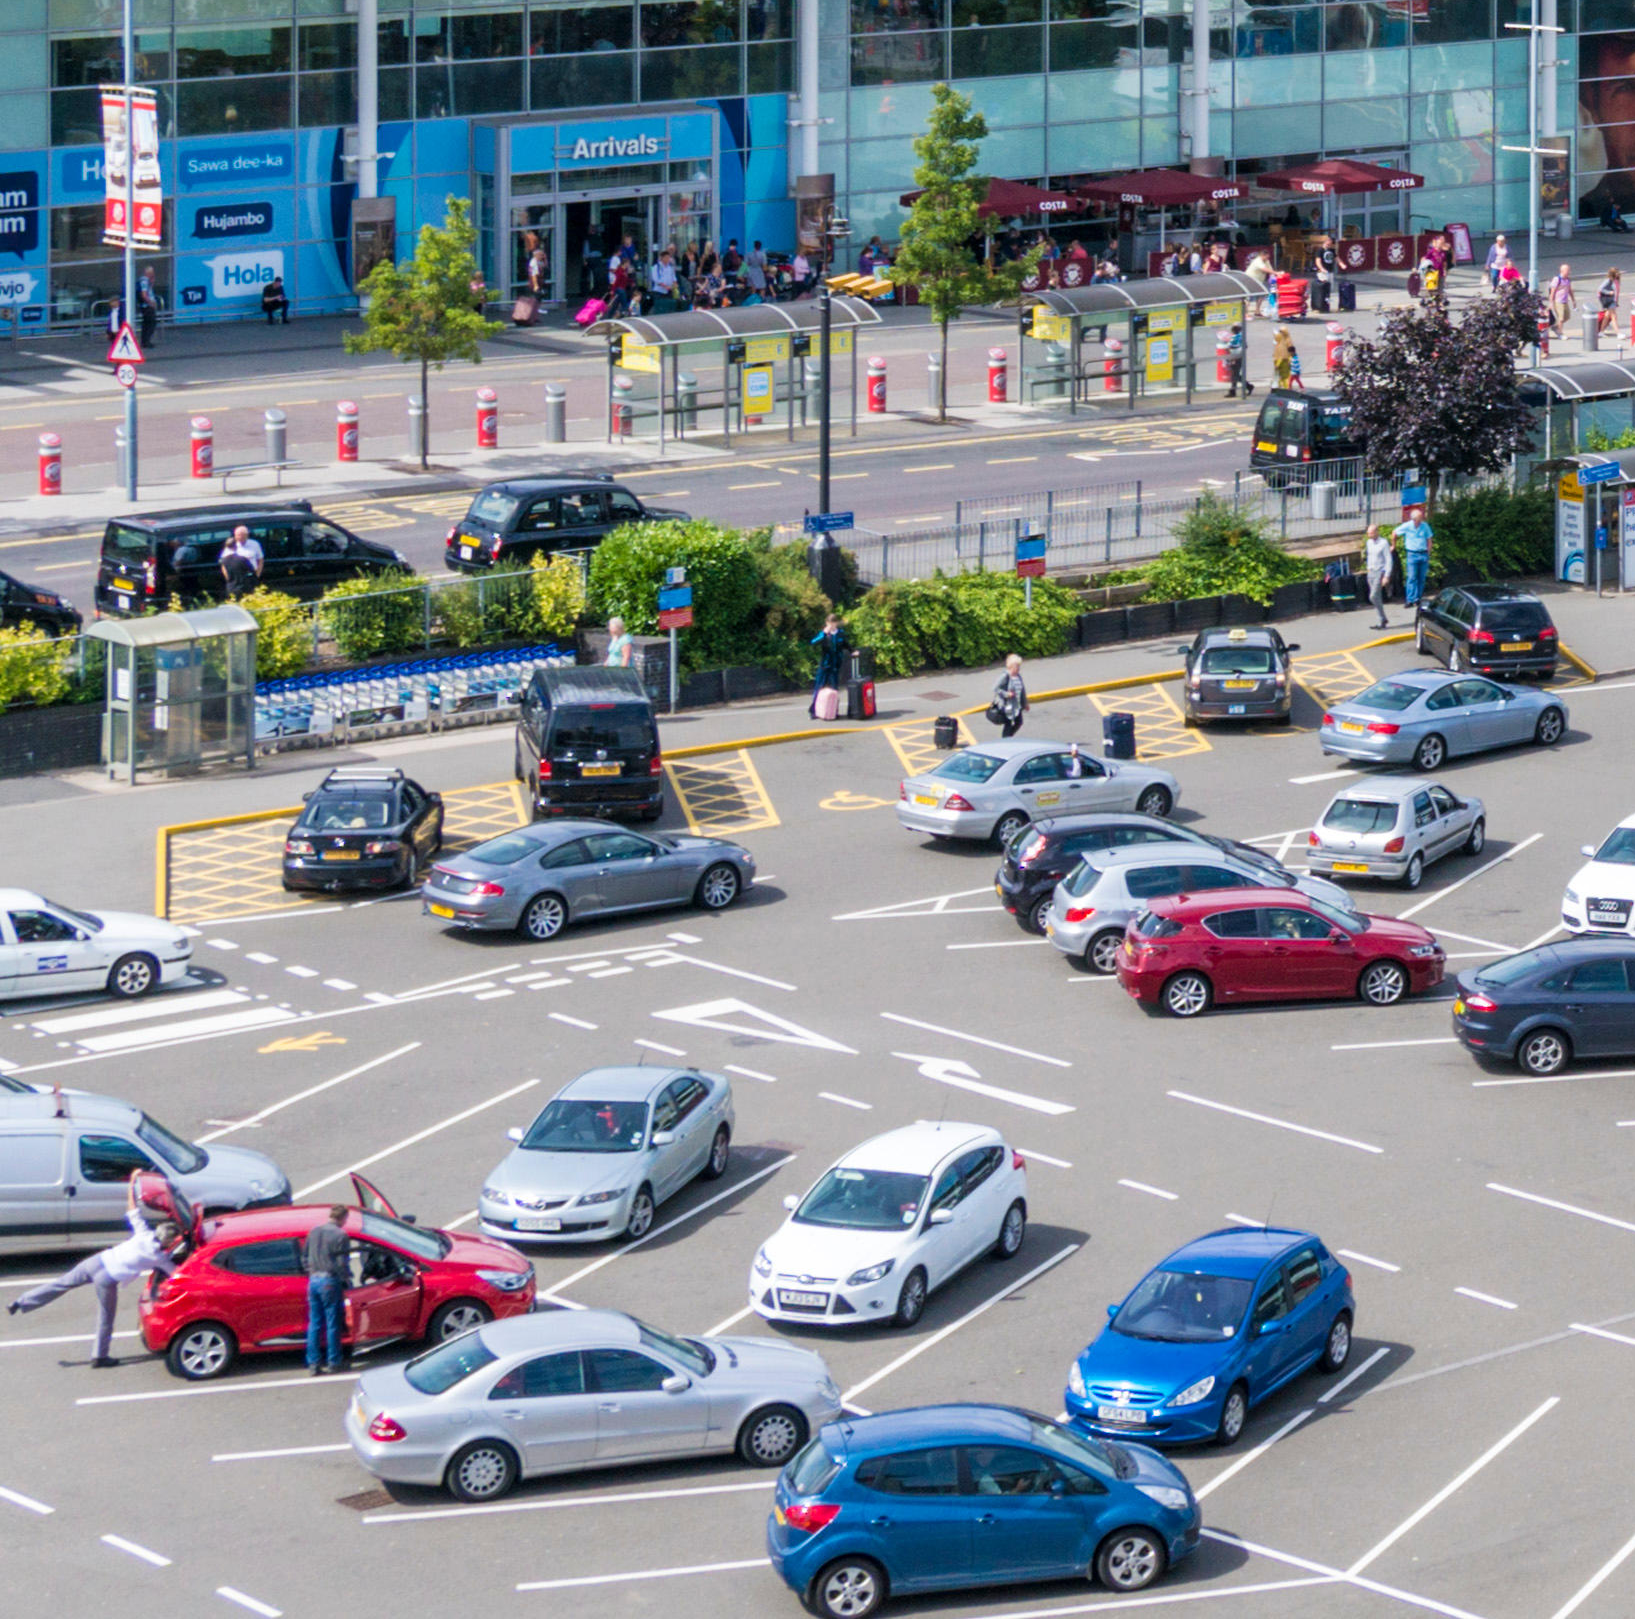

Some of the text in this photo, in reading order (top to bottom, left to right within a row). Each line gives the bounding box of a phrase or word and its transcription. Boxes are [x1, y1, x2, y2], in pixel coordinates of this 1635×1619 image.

[572, 134, 659, 160] Arrivals
[188, 154, 284, 173] Sawa dee-ka
[1302, 181, 1325, 192] COSTA
[1390, 178, 1415, 189] COSTA
[1121, 193, 1143, 204] COSTA
[1212, 188, 1239, 199] COSTA
[1039, 201, 1067, 211] COSTA
[203, 212, 265, 231] Hujambo
[224, 263, 274, 286] Hola
[1324, 406, 1352, 415] TAXI
